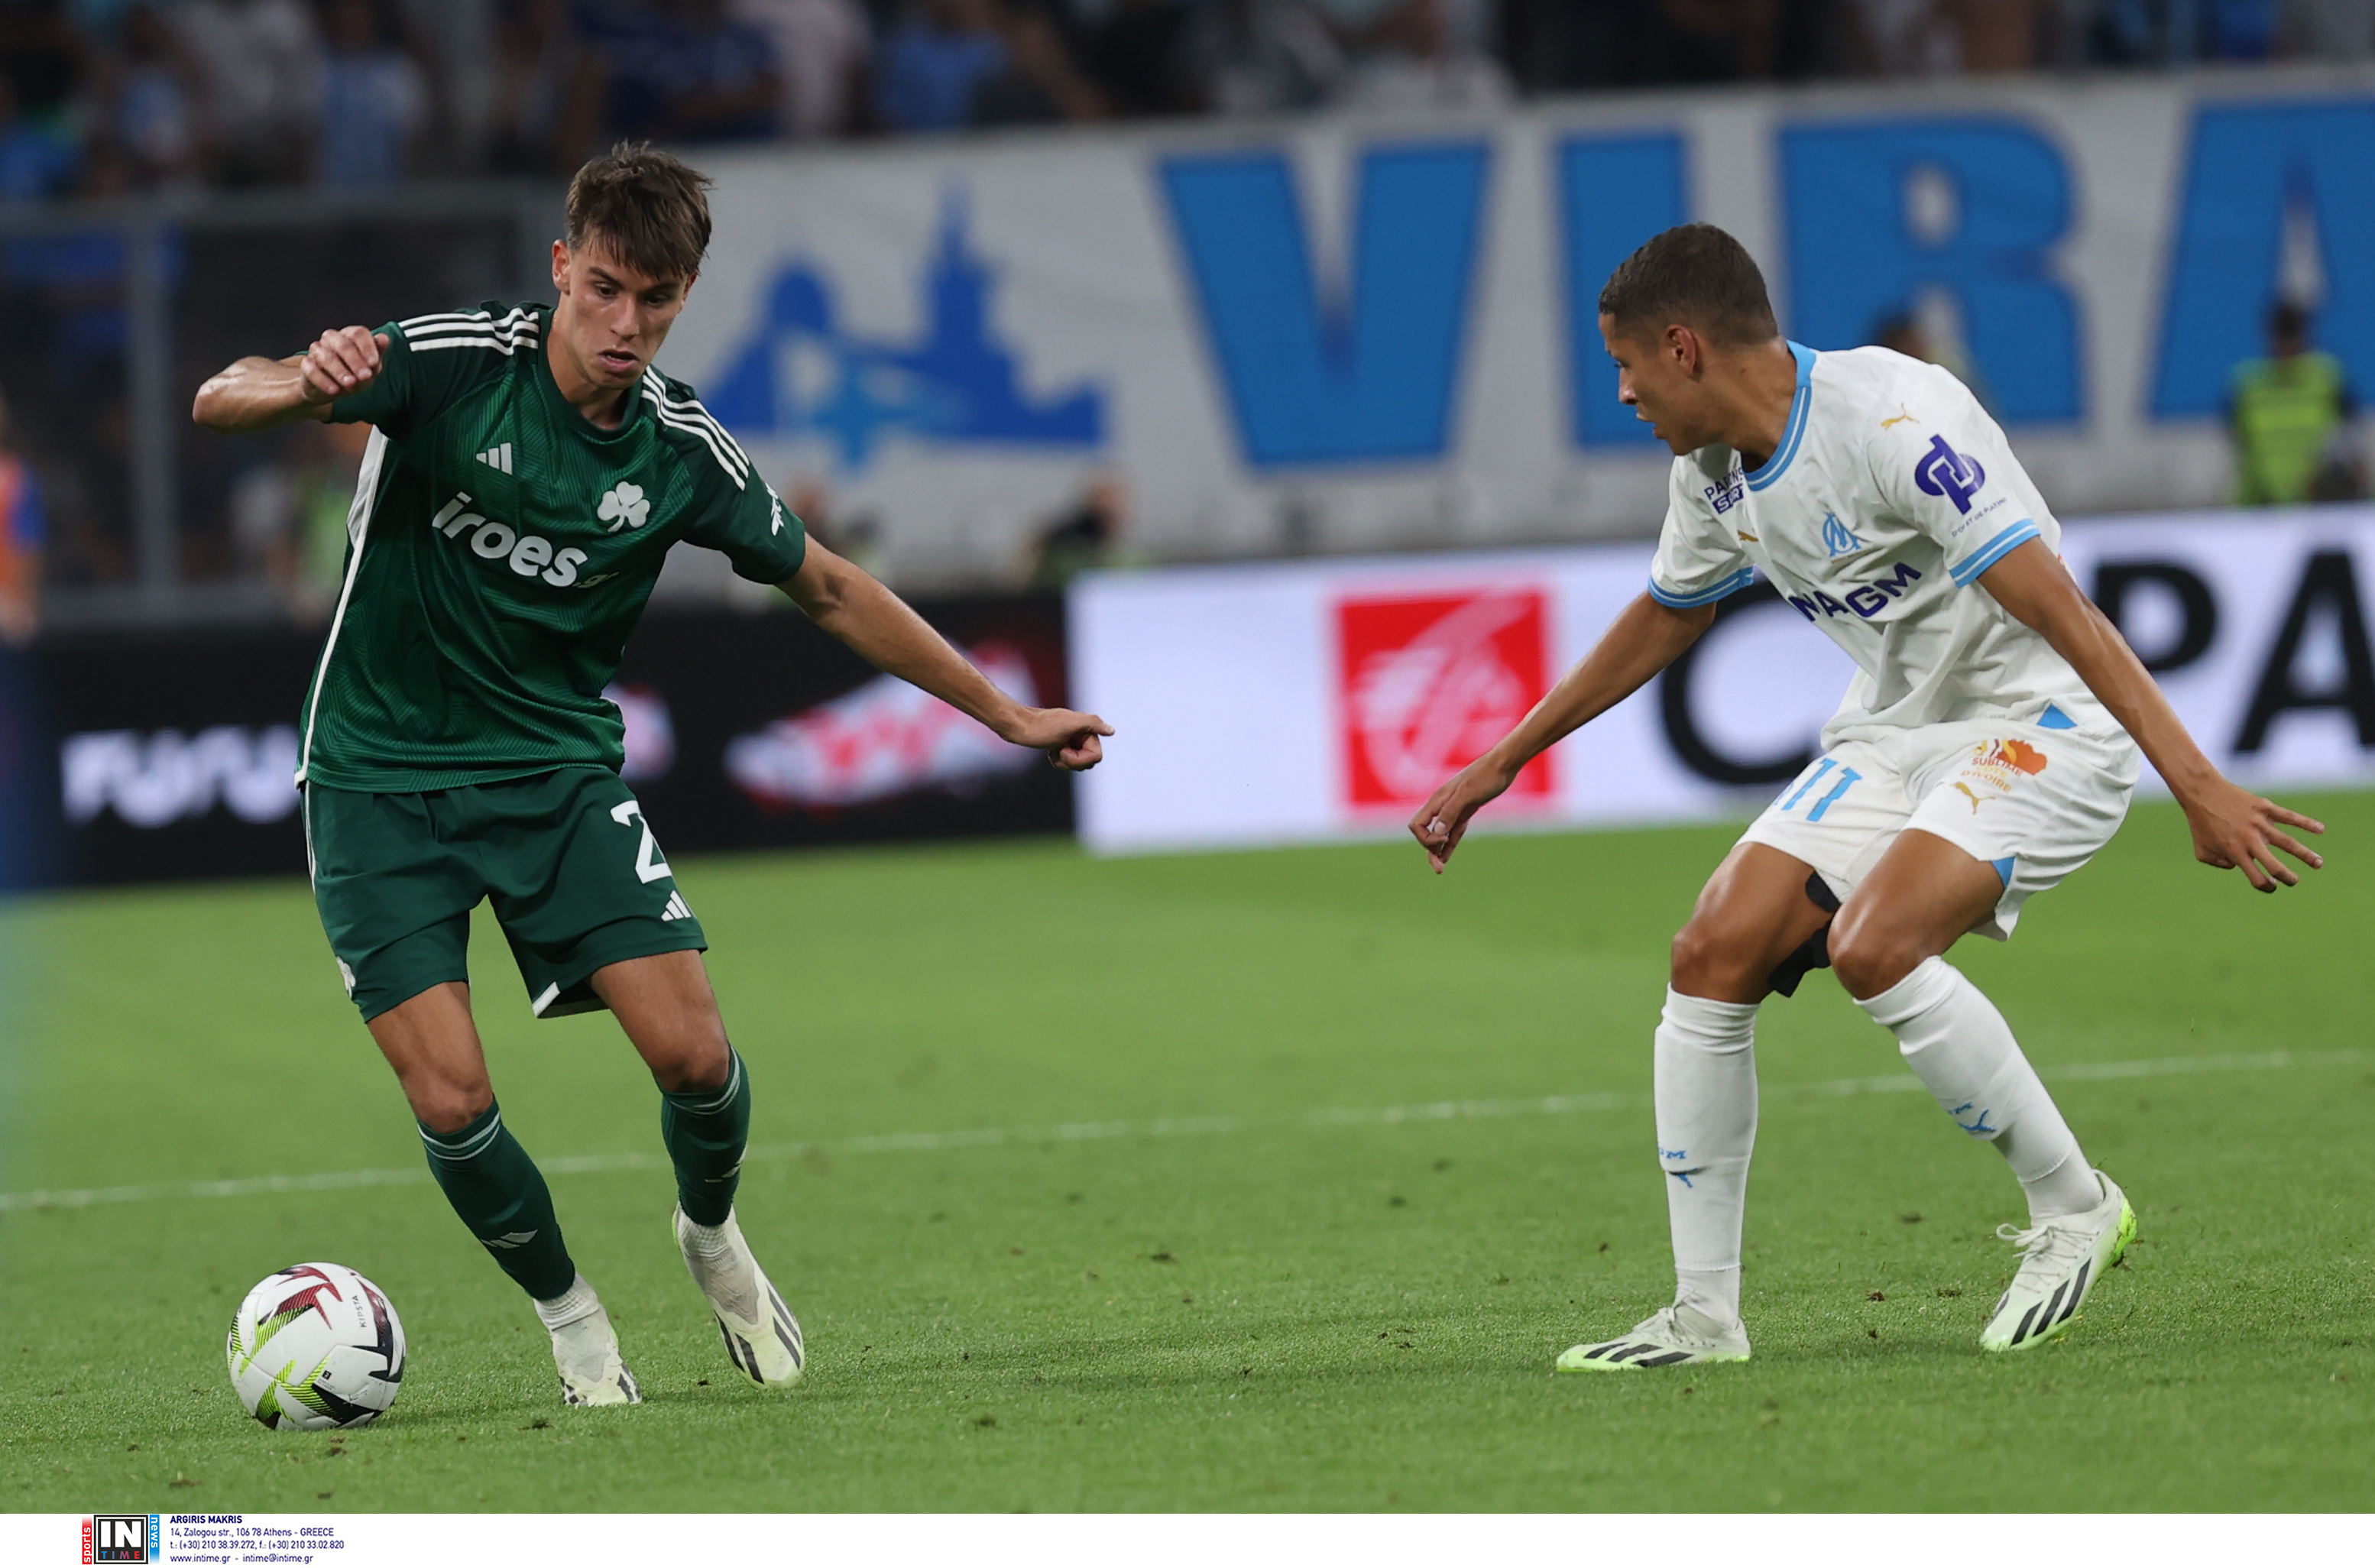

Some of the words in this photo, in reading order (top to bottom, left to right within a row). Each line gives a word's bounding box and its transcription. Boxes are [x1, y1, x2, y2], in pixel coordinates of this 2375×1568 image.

[1780, 757, 1863, 822] 11
[611, 799, 673, 884] 2
[352, 1295, 367, 1328] KIPSTA
